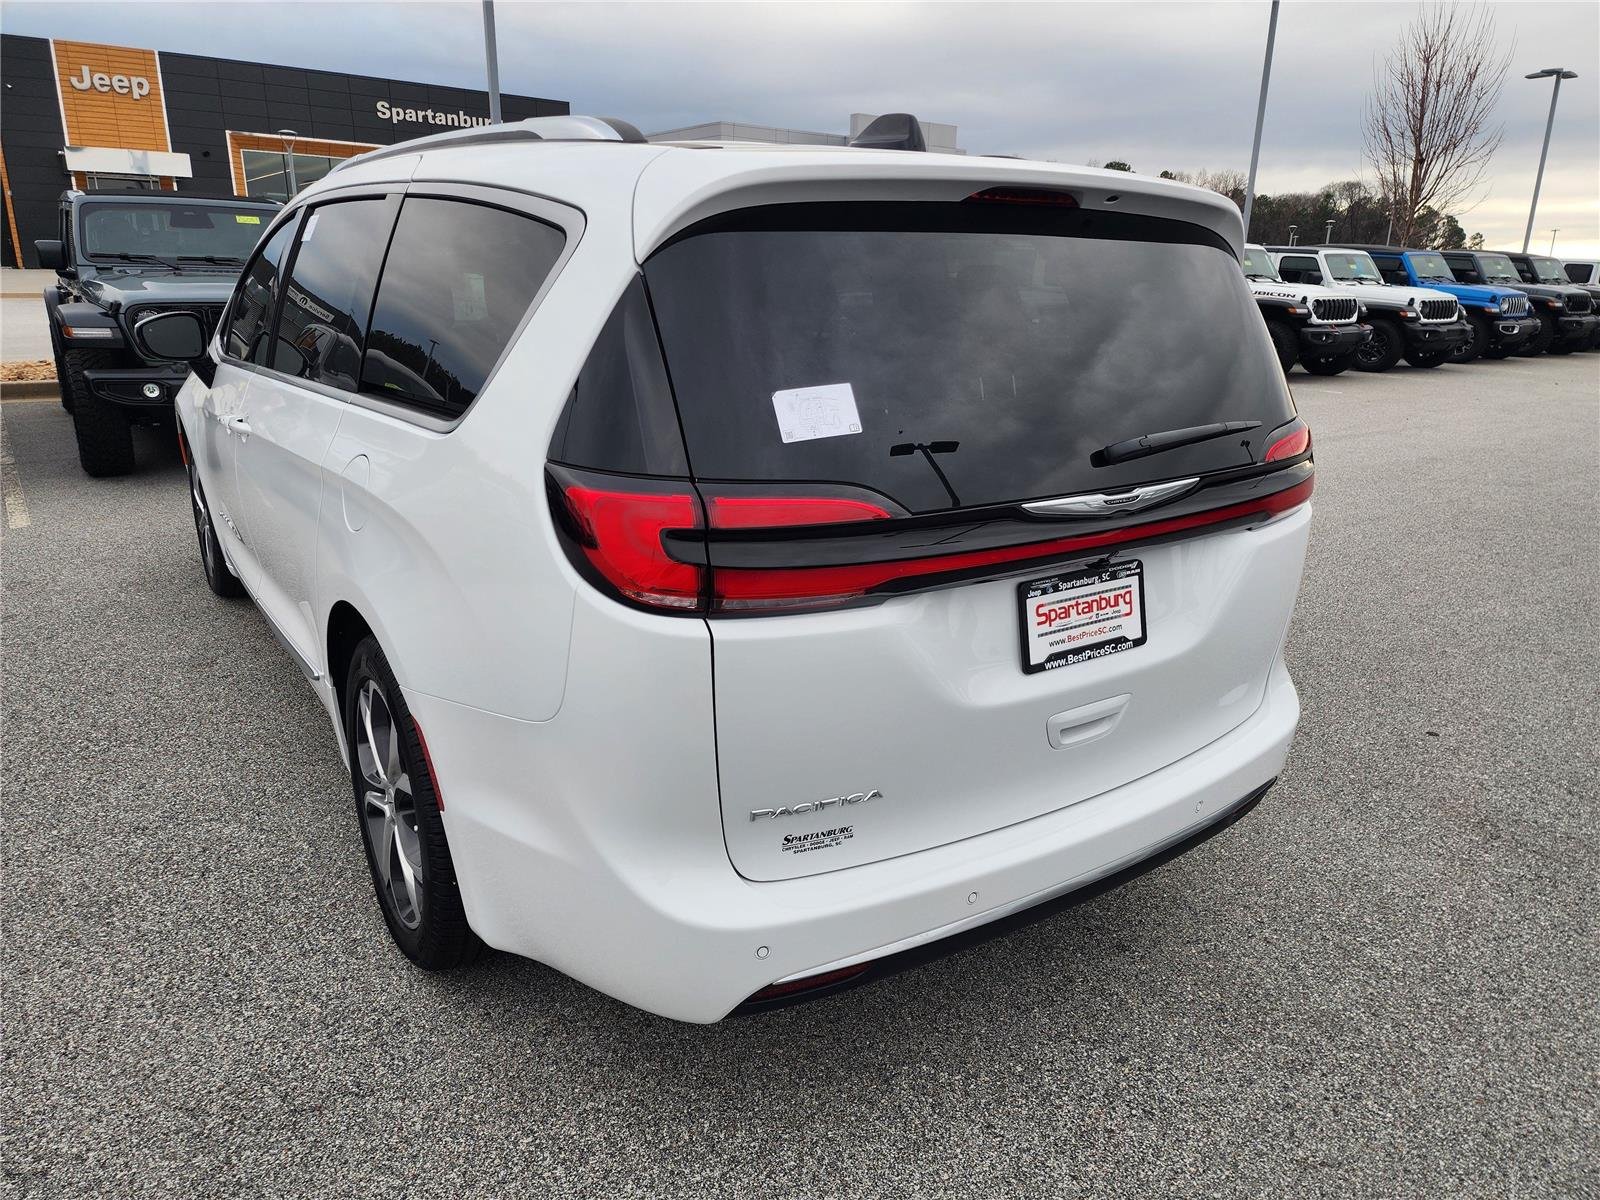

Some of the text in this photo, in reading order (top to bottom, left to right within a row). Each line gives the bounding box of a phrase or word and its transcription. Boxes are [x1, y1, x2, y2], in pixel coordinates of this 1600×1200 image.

[70, 65, 151, 101] Jeep
[376, 100, 494, 128] Spartanbur
[1251, 290, 1296, 299] UBICON
[1027, 589, 1042, 598] Jeep
[1058, 572, 1111, 591] Spartanburg, SC
[1036, 590, 1134, 627] Spartanburg
[1048, 623, 1123, 648] www.BestPriceSC.com
[1044, 640, 1134, 670] www.BestPriceSC.com
[749, 788, 884, 822] PACIFICA
[782, 825, 854, 846] SPARTANBURG
[793, 844, 835, 855] SPARTANBURG,
